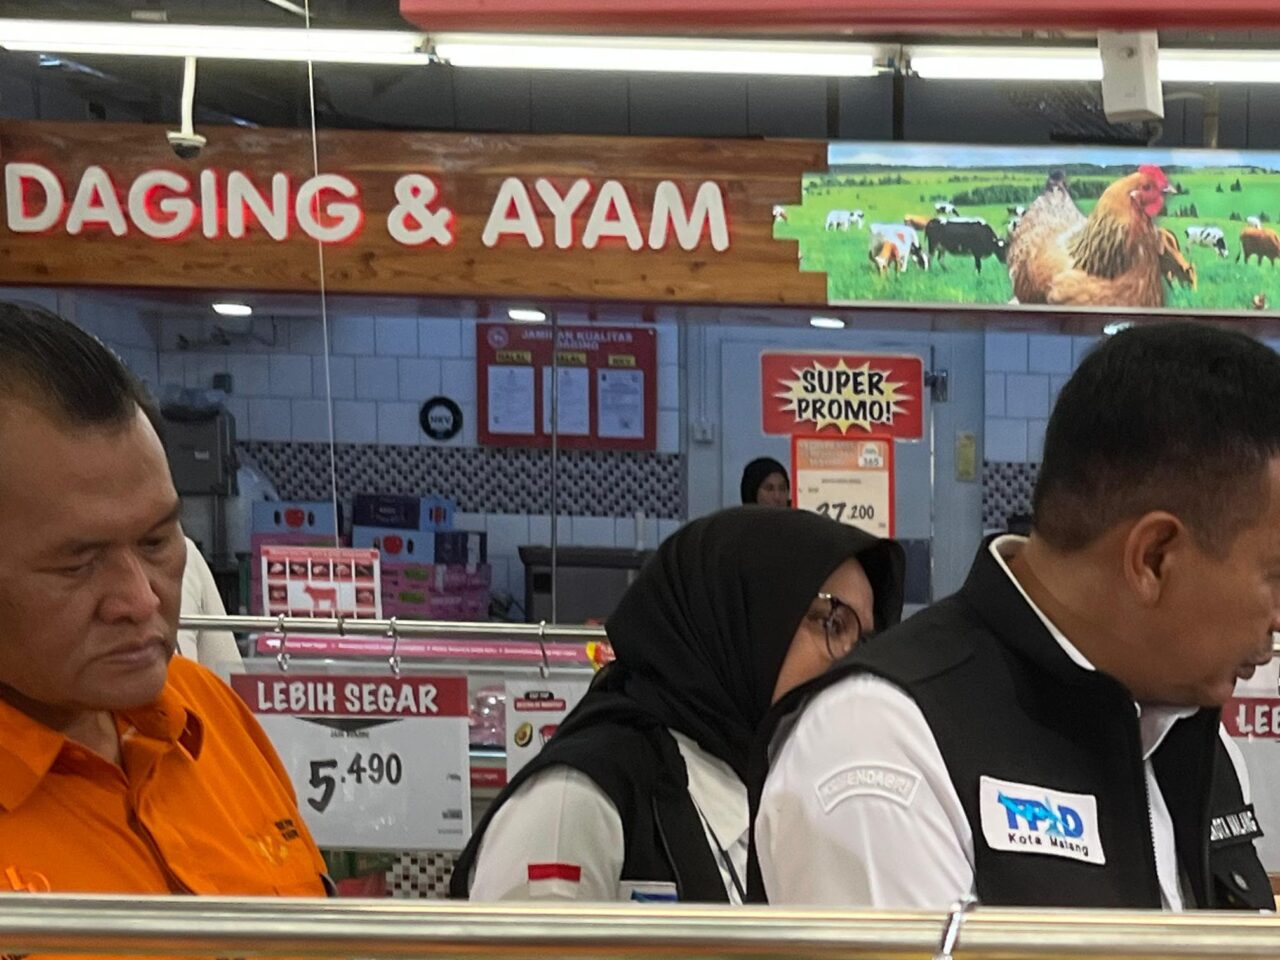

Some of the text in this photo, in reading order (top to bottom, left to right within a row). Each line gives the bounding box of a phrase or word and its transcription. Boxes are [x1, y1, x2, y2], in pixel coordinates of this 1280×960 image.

[4, 162, 730, 252] DAGING & AYAM
[802, 369, 884, 396] SUPER
[797, 398, 891, 422] PROMO!
[257, 681, 439, 713] LEBIH SEGAR
[307, 753, 402, 814] 5.490
[1008, 833, 1090, 857] Kota Malang
